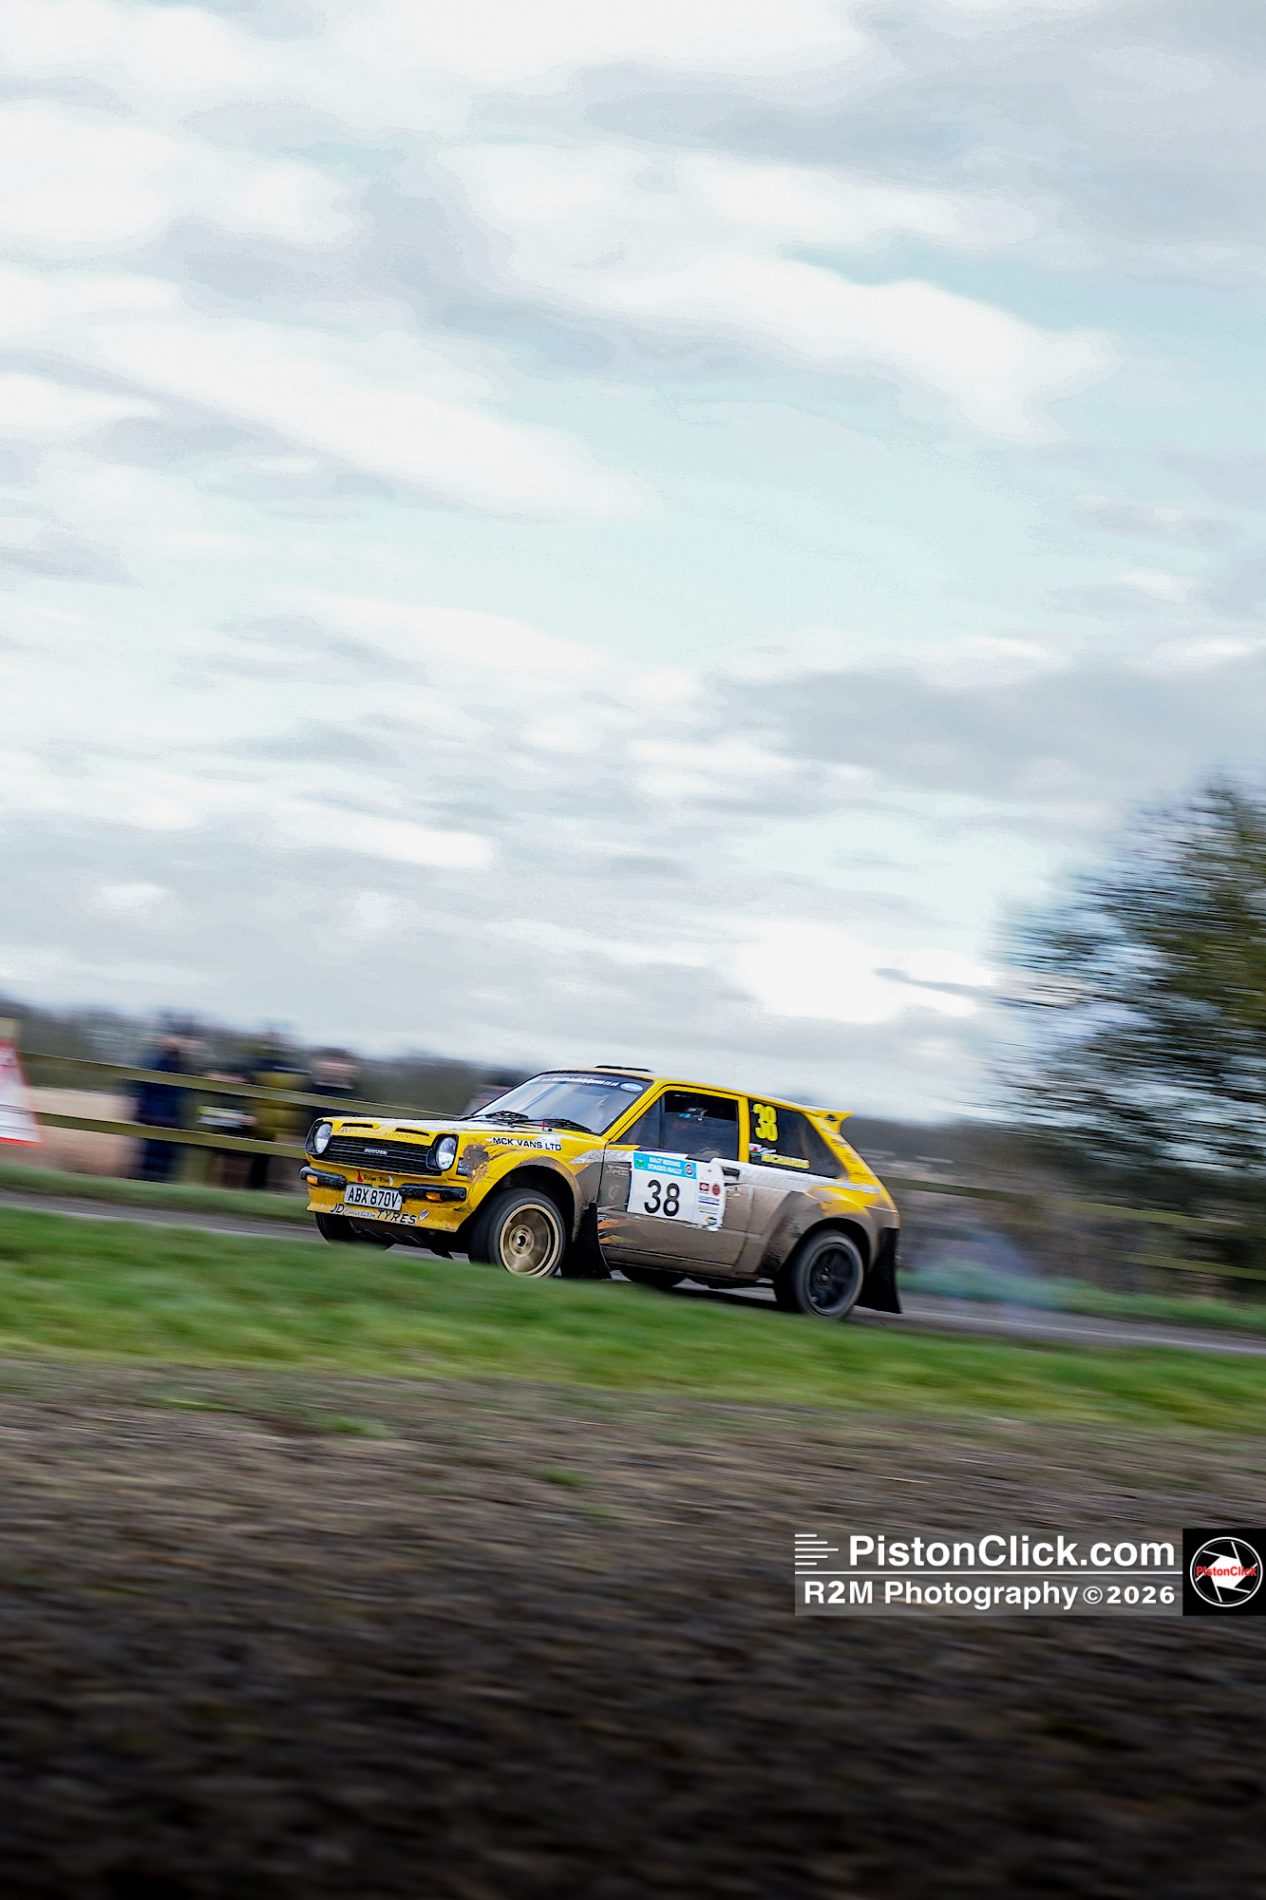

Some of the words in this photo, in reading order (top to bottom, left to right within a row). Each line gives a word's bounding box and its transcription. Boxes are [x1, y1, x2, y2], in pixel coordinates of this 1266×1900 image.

[753, 1103, 778, 1141] 38
[517, 1139, 543, 1149] VANS
[545, 1143, 562, 1151] LTD
[348, 1187, 369, 1204] ABX
[370, 1190, 399, 1207] 870V
[644, 1180, 680, 1217] 38
[331, 1203, 345, 1214] JD
[377, 1208, 417, 1225] TYRES
